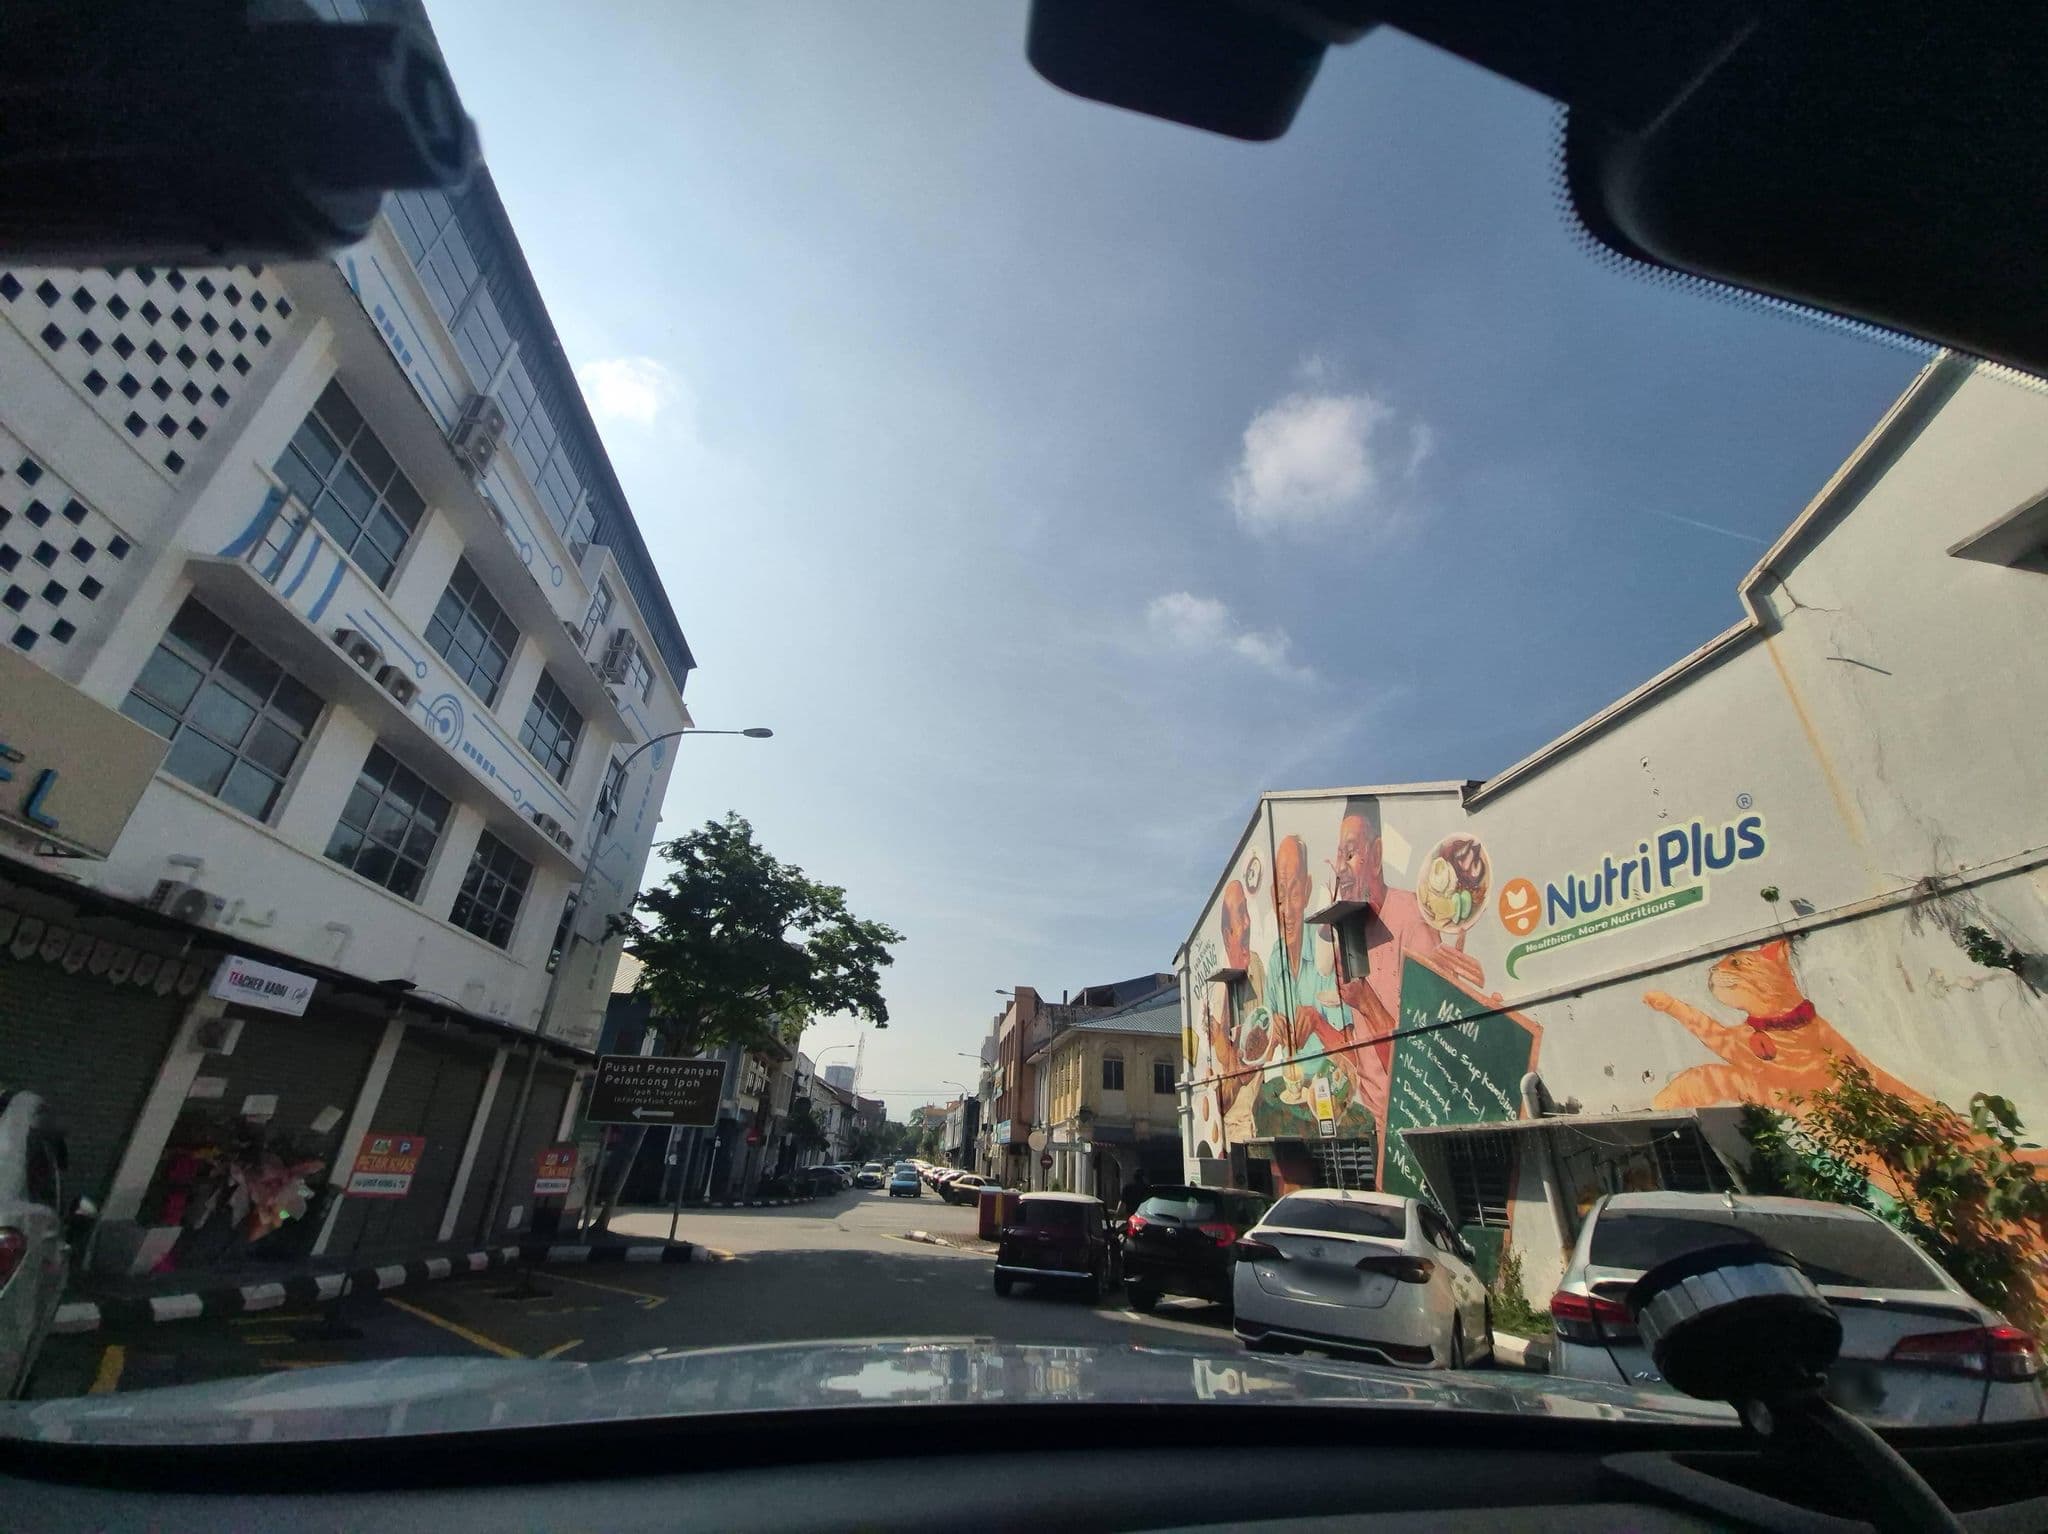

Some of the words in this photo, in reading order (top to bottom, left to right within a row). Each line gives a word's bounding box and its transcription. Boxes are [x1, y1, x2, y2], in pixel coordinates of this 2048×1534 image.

[1578, 919, 1609, 937] More
[1610, 899, 1677, 926] Nutritious
[228, 970, 265, 992] TEACHER
[605, 1062, 641, 1073] Pusat
[647, 1064, 719, 1077] Penerangan
[605, 1074, 668, 1088] Pelancong
[674, 1078, 701, 1088] Ipoh
